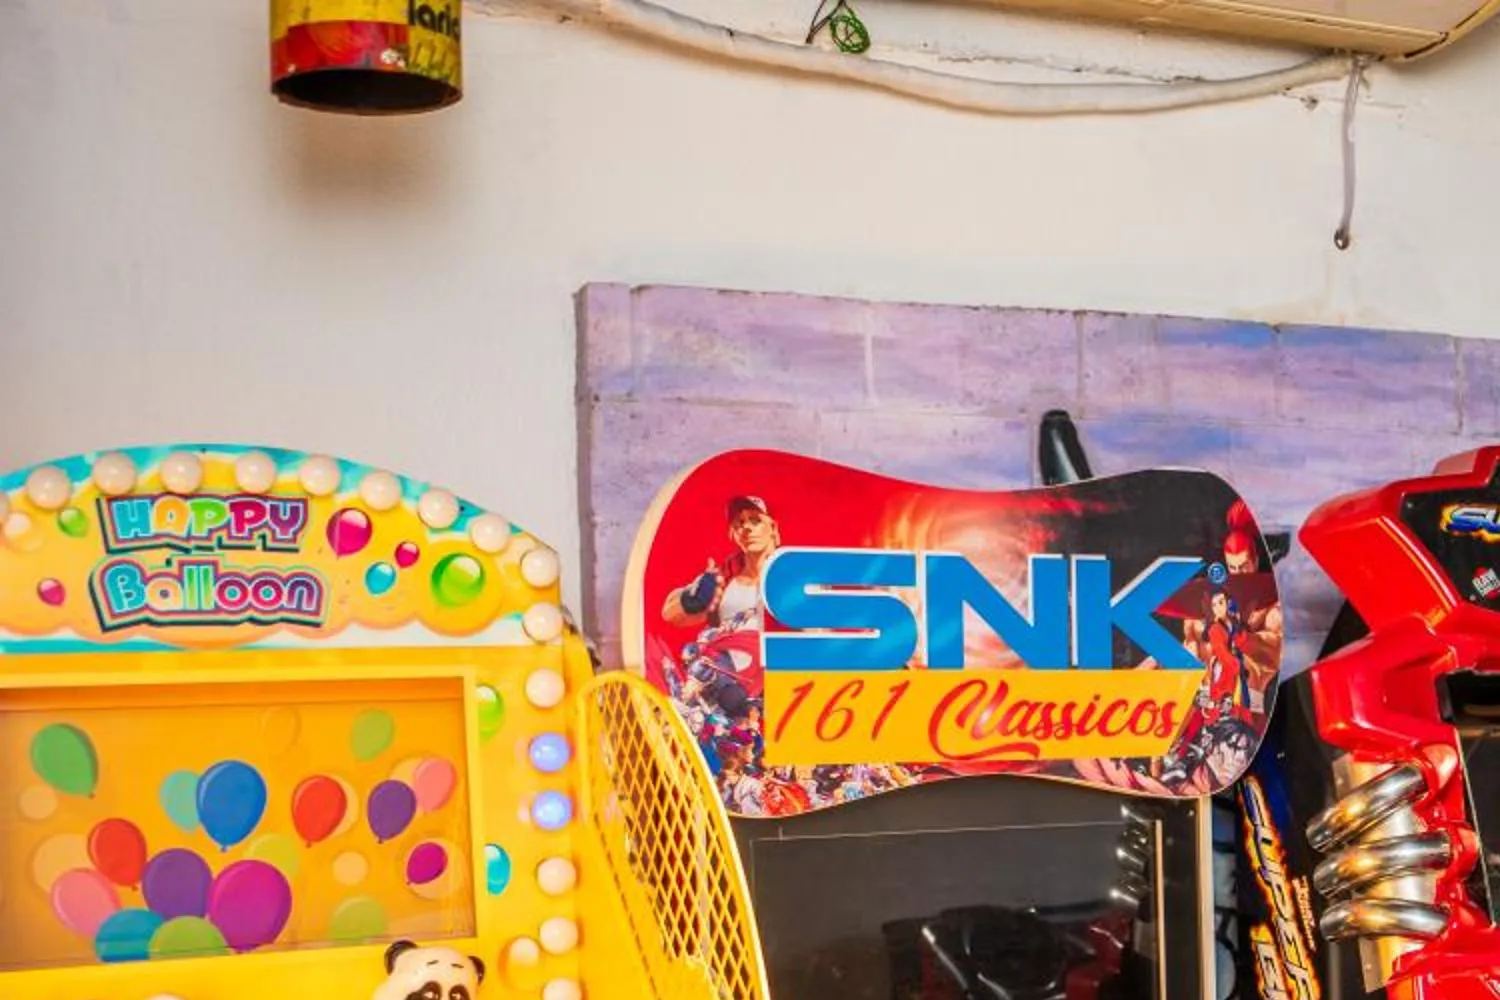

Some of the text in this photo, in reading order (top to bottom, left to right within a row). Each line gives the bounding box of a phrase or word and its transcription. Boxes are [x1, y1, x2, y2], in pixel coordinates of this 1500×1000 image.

[110, 496, 305, 540] HAPPY
[104, 564, 319, 616] Balloon
[762, 546, 1205, 671] SNK
[773, 678, 1179, 760] 161 Classicos
